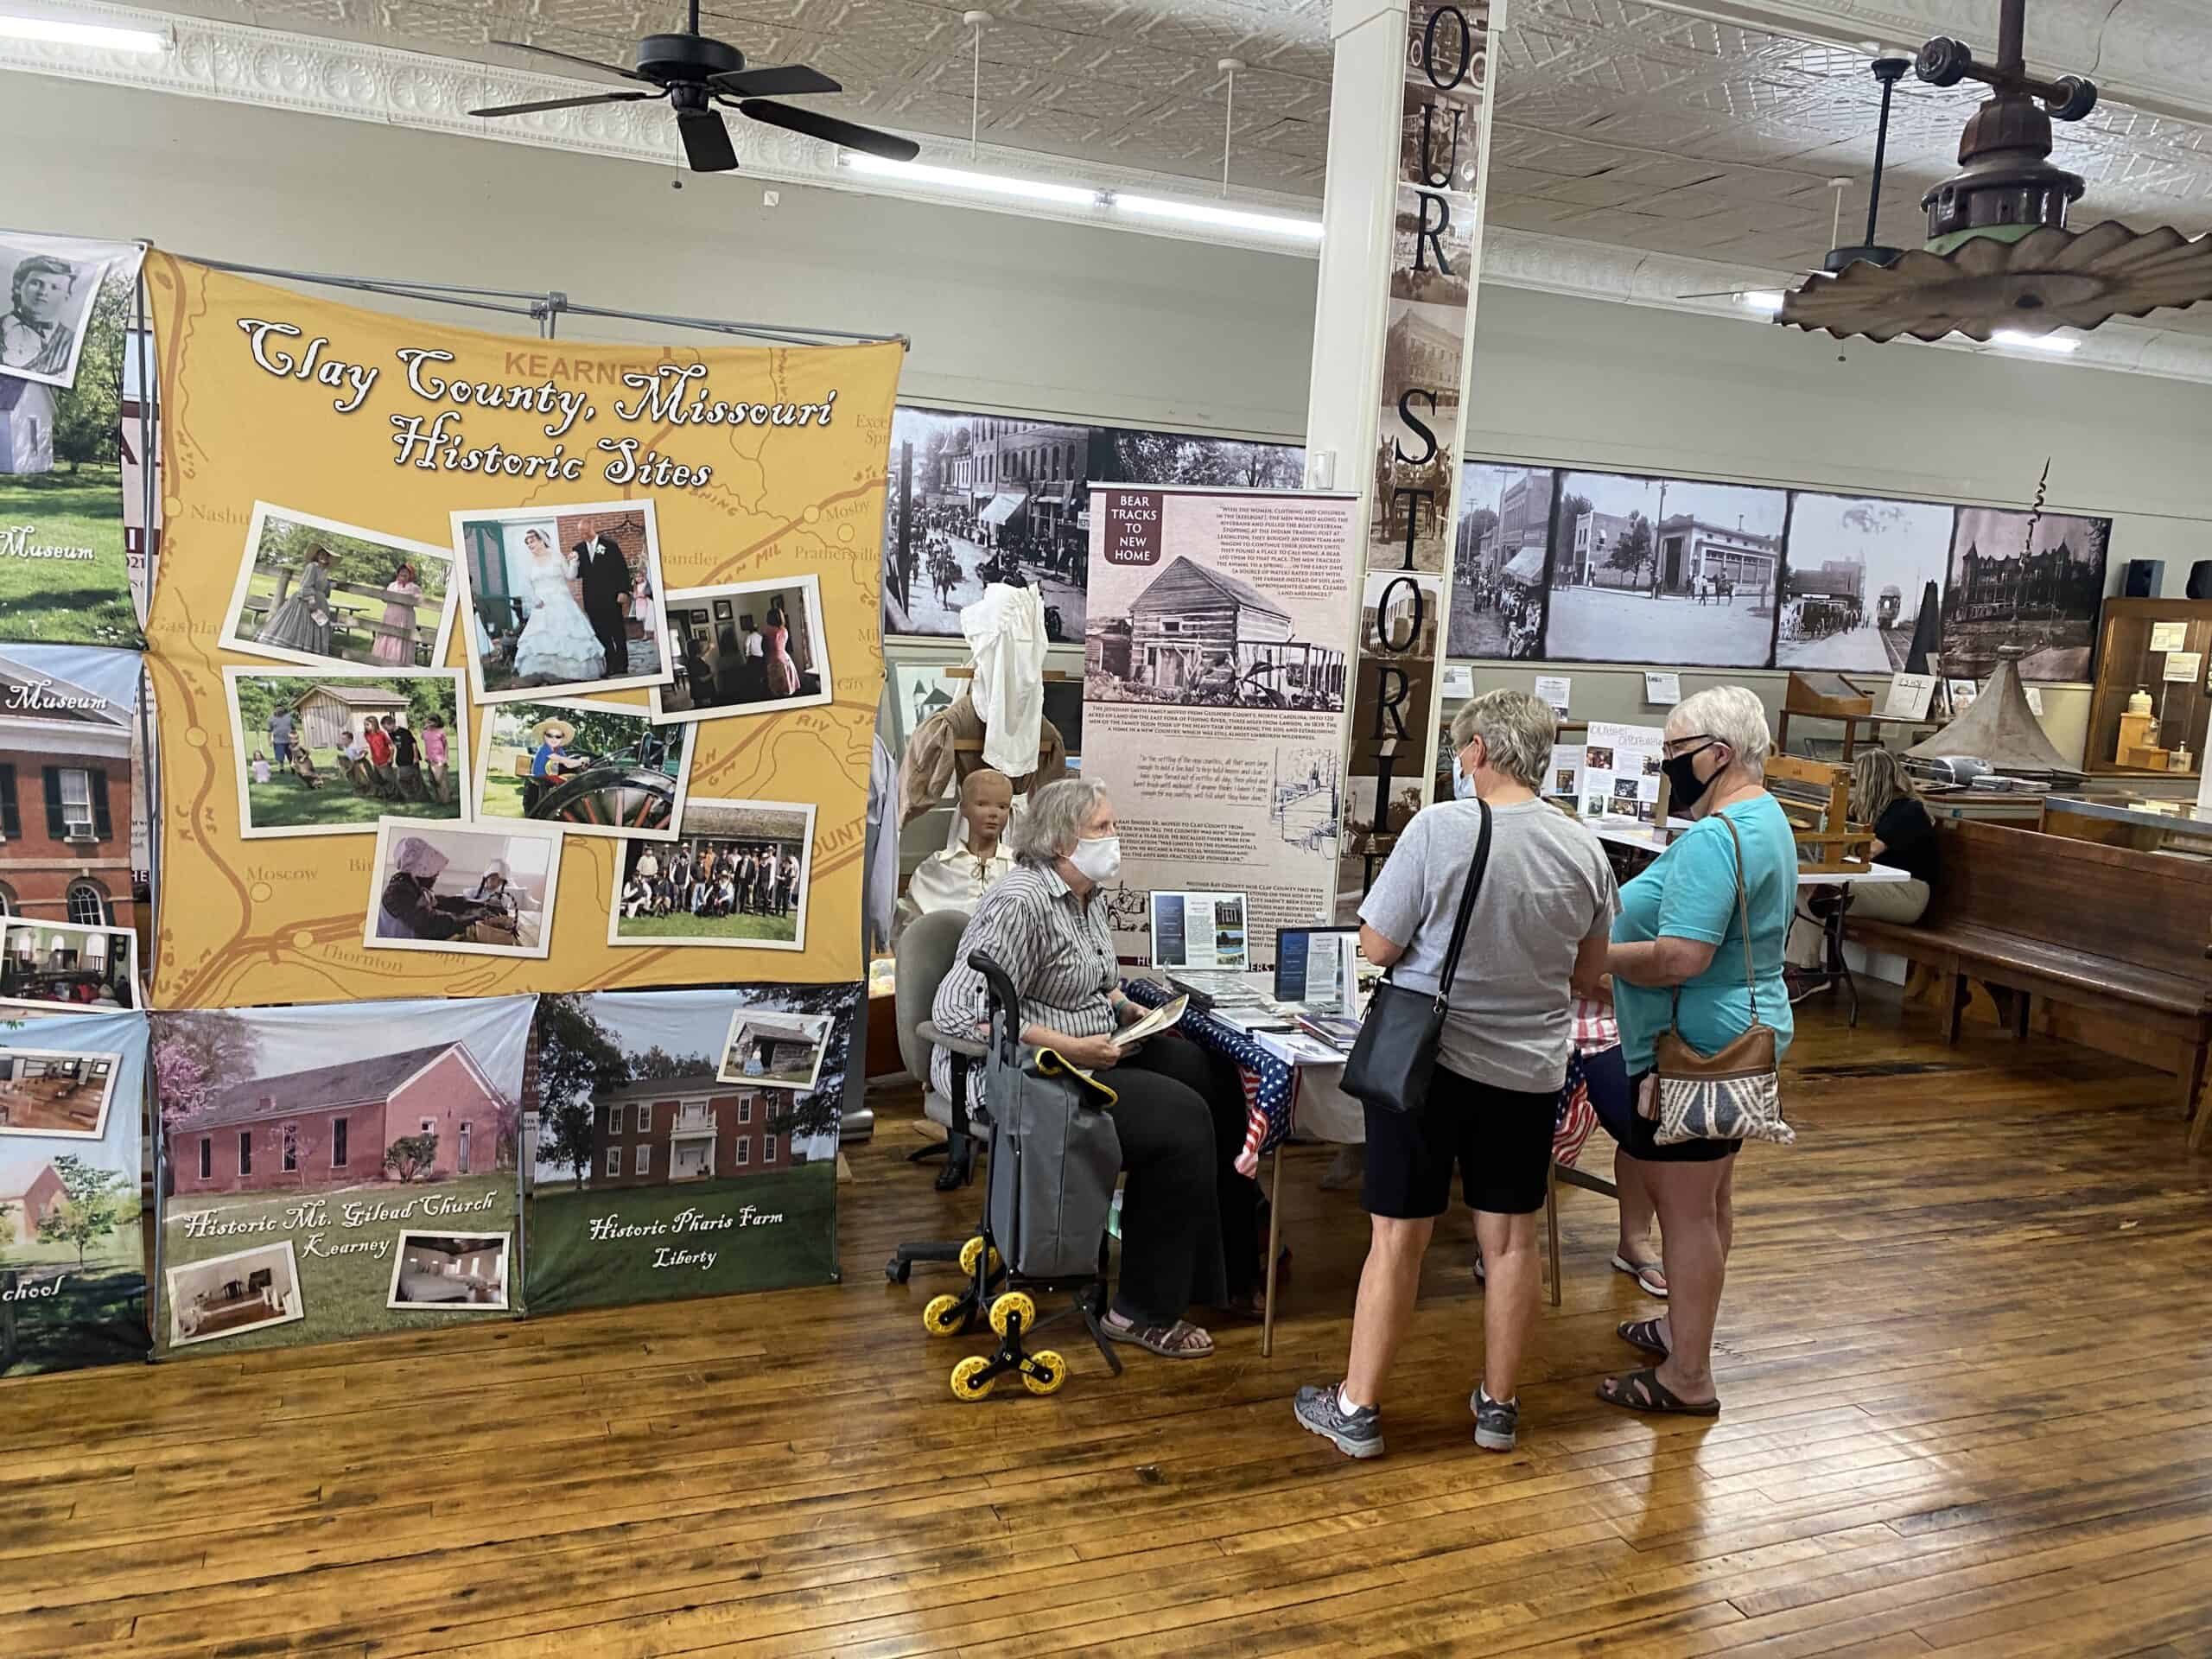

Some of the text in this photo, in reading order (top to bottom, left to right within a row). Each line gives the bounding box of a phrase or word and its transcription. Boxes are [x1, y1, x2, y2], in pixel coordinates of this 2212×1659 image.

[1408, 4, 1471, 277] OUR
[237, 317, 379, 412] Clay
[395, 347, 596, 437] County,
[614, 364, 838, 427] Missouri
[389, 411, 715, 487] Historic Sites
[191, 504, 250, 525] Nashu
[1111, 508, 1158, 521] TRACKS
[1120, 495, 1150, 507] BEAR
[1125, 522, 1142, 534] TO
[0, 525, 94, 560] Museum
[1119, 536, 1147, 548] NEW
[1114, 550, 1151, 562] HOME
[4, 679, 108, 711] Museum
[246, 865, 318, 881] Moscow
[321, 944, 403, 973] Thornton
[184, 1188, 499, 1239] Historic Mt. Gilead Church
[588, 1205, 784, 1241] Historic Pharis Farm
[302, 1233, 391, 1260] Kearney
[652, 1247, 718, 1270] Liberty
[2, 1274, 67, 1302] chool
